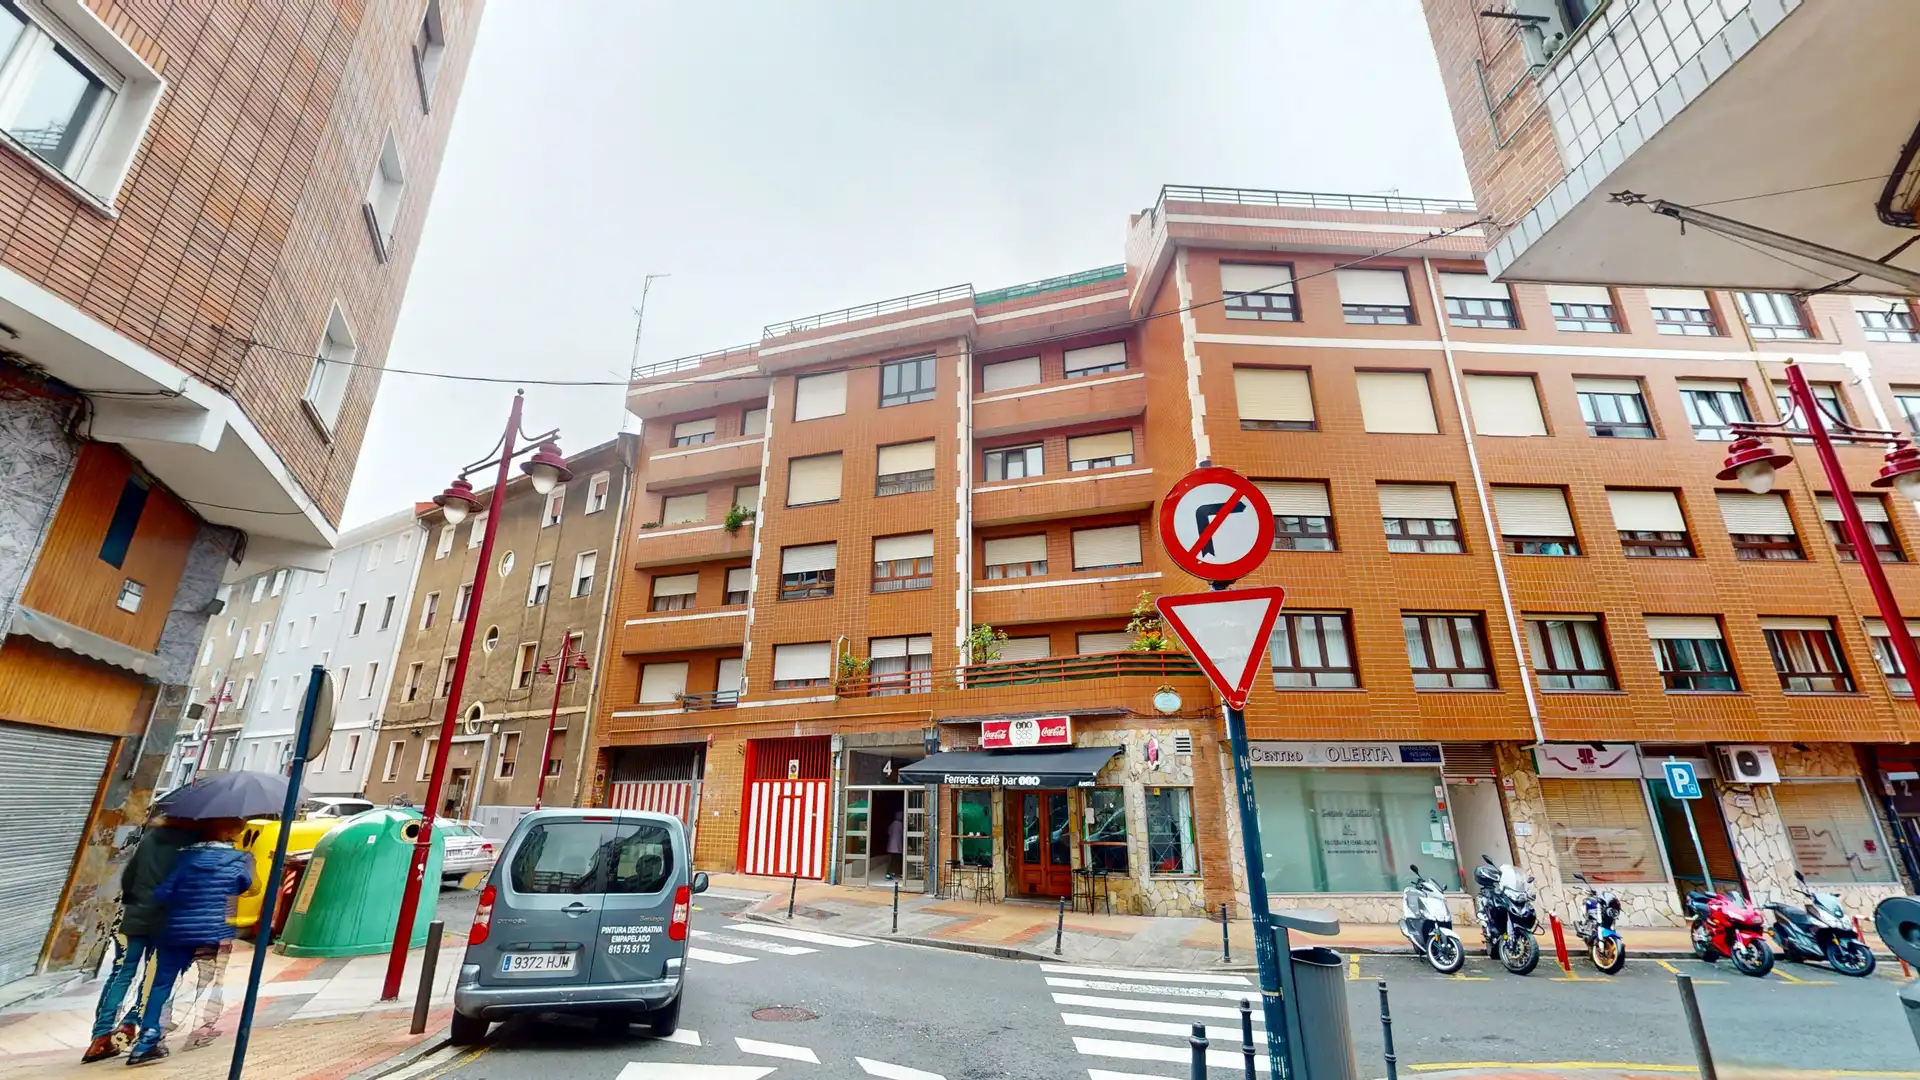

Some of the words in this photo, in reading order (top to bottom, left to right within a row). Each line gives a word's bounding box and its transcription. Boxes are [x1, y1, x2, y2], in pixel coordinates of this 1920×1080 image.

[984, 729, 1007, 740] Coca-Cola
[1041, 725, 1066, 737] Coca-Cola
[1325, 746, 1394, 762] OLERTA
[882, 760, 893, 776] 4
[980, 774, 1000, 785] café
[1002, 775, 1017, 785] bar
[1671, 768, 1690, 793] P
[1900, 780, 1913, 797] 2
[601, 926, 627, 934] PINTURA
[627, 926, 663, 934] DECORATIVA
[611, 935, 651, 943] EMPAPELADO
[608, 945, 621, 954] 615
[622, 945, 631, 954] 75
[631, 945, 641, 954] 51
[642, 944, 650, 953] 72
[514, 956, 544, 969] 9372
[546, 956, 570, 969] HJM
